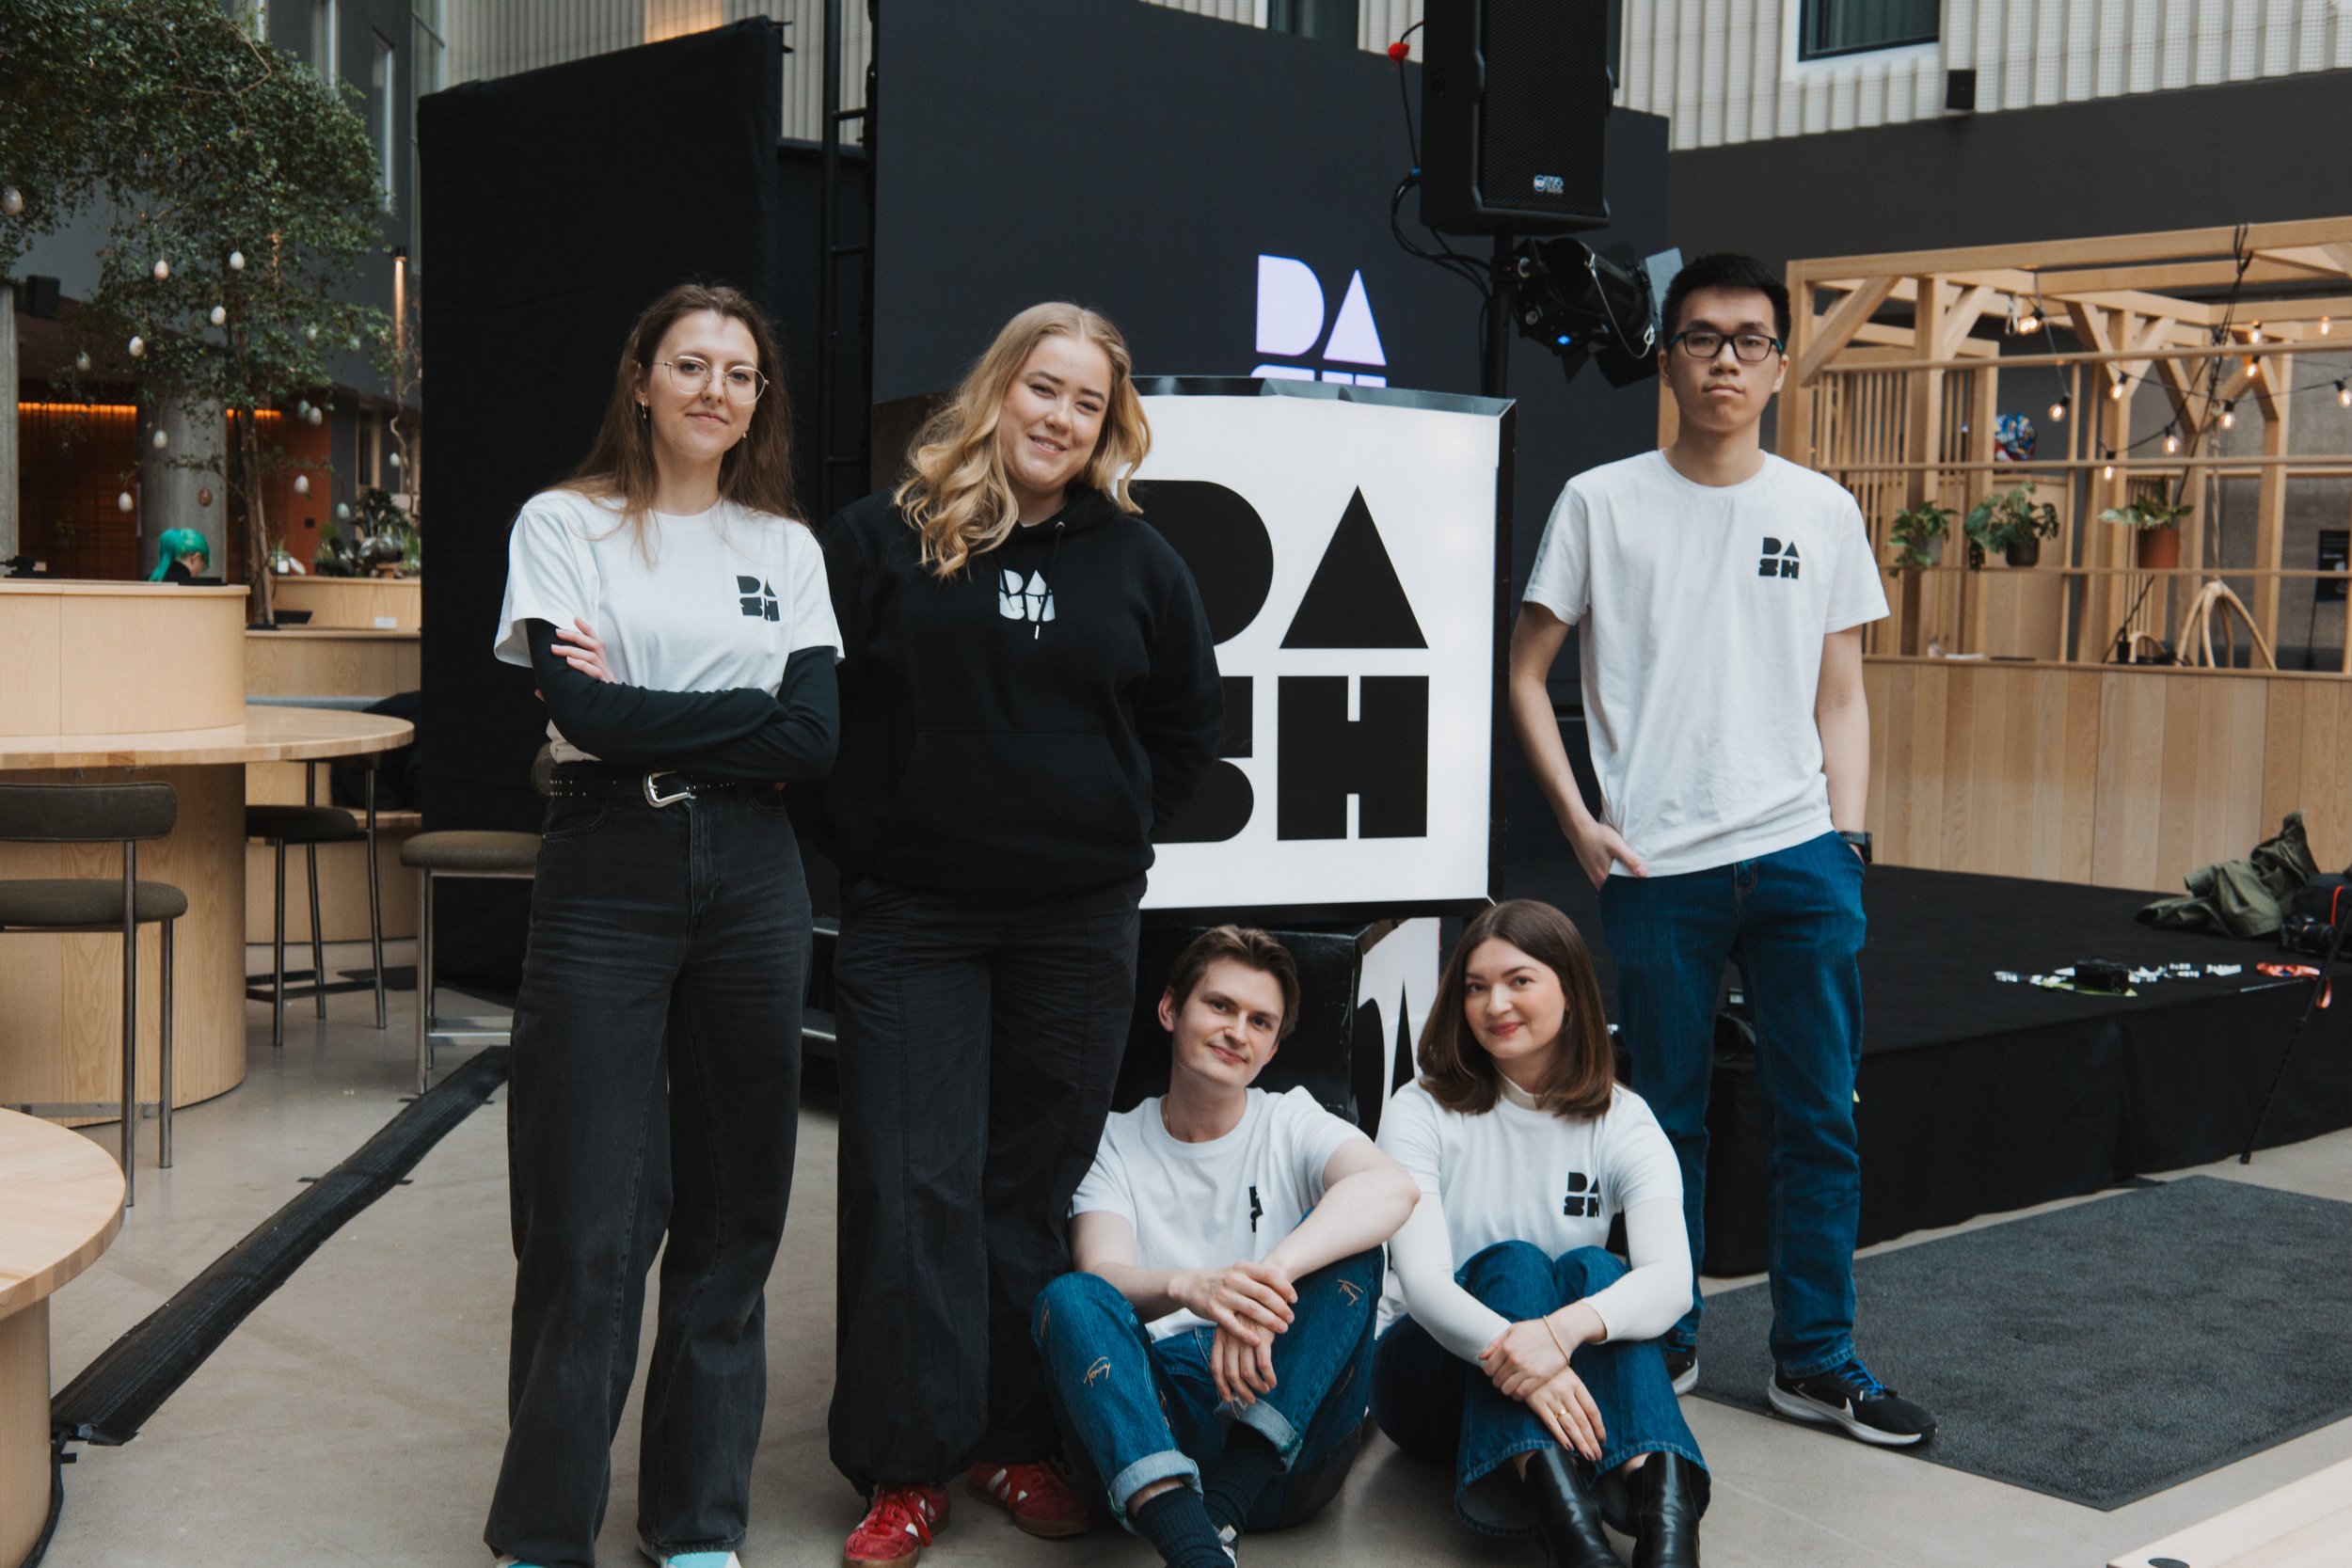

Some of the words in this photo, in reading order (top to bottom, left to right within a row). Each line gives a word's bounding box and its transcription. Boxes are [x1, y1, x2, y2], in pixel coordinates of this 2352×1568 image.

[1255, 254, 1388, 367] DA
[1762, 536, 1800, 559] DA
[1758, 558, 1800, 579] SH
[736, 575, 777, 597] DA
[739, 596, 781, 623] SH
